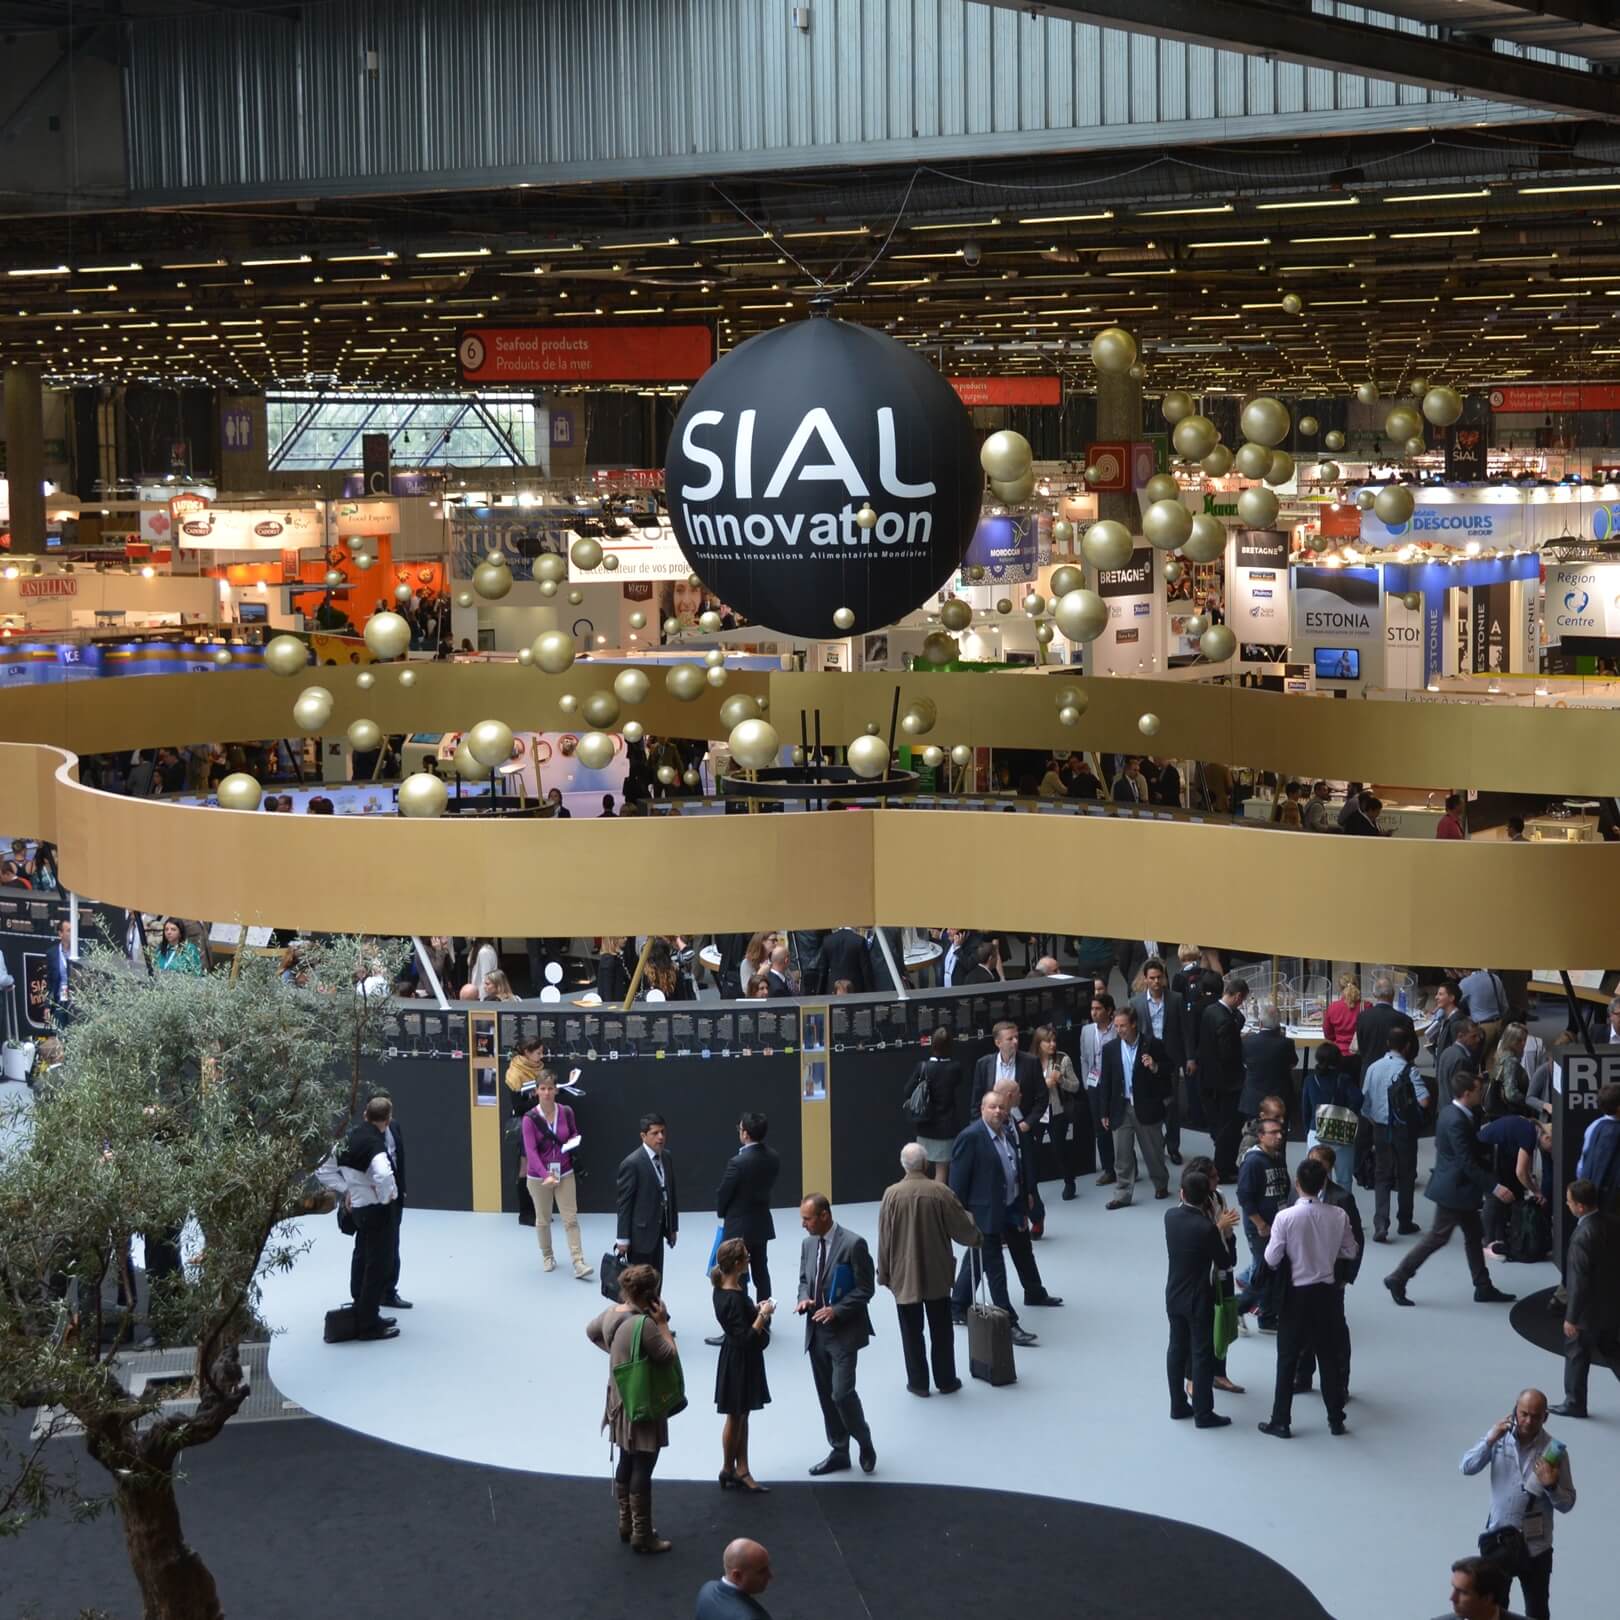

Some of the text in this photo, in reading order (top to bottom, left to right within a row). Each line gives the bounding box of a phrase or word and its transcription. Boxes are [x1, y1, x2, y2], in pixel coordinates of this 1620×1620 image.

[467, 337, 476, 358] 6
[495, 336, 589, 354] Seafood products
[496, 356, 540, 371] Produits
[543, 356, 556, 369] de
[558, 356, 567, 368] la
[681, 407, 937, 501] SIAL
[1452, 450, 1479, 462] SIAL
[1413, 515, 1493, 530] DESCOURS
[743, 551, 804, 560] Innovations
[809, 551, 878, 560] Alimentaires
[881, 550, 927, 559] Mondiales
[1100, 568, 1146, 584] BRETAGNE
[1557, 571, 1596, 587] Région
[20, 578, 77, 596] CASTELLINO
[1305, 612, 1370, 628] ESTONIA
[1556, 615, 1595, 627] Centre
[1477, 602, 1486, 672] ESTONIE
